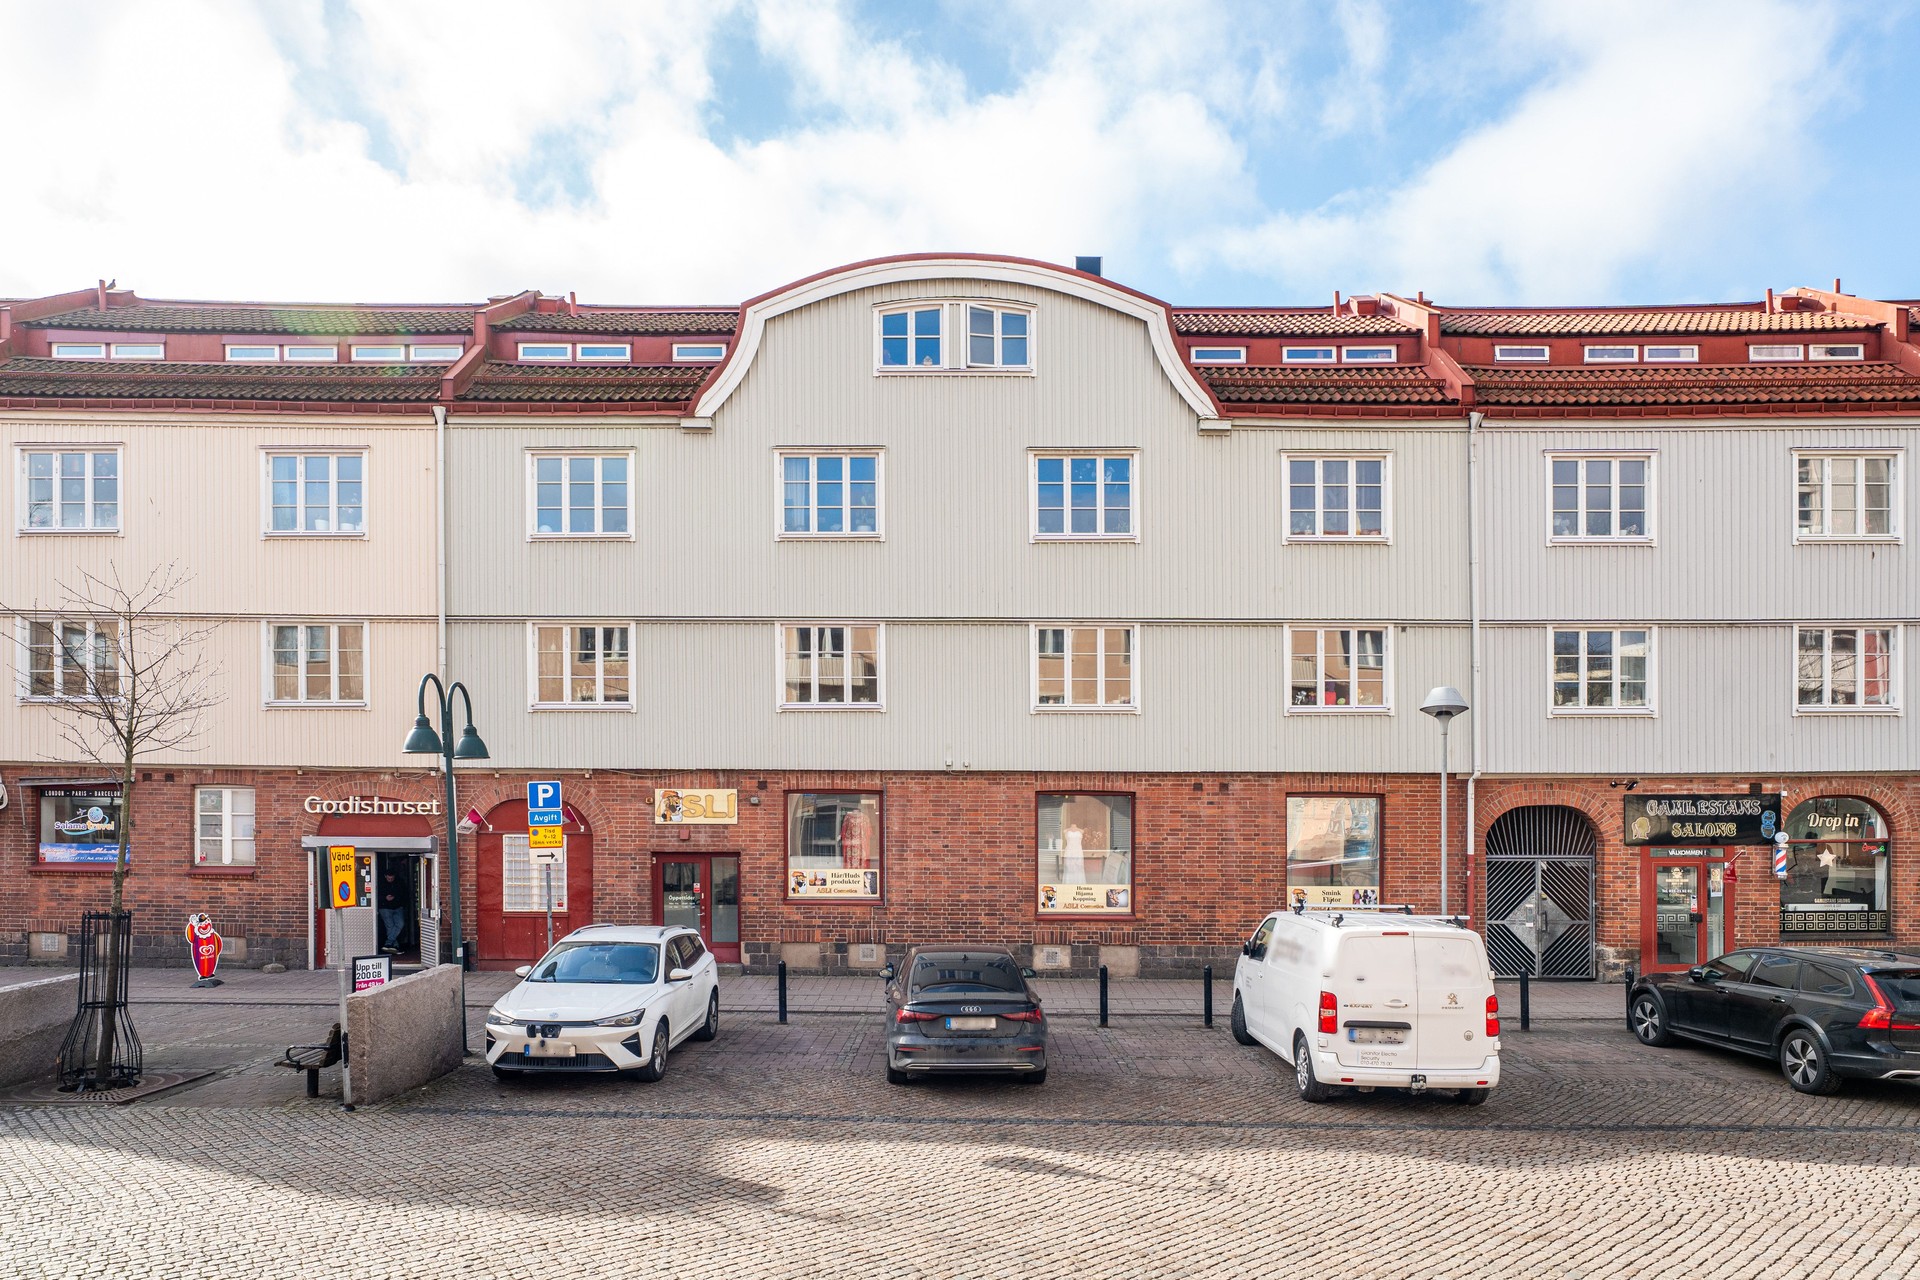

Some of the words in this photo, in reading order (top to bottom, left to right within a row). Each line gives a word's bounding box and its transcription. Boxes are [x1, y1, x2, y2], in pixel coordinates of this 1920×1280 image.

[538, 784, 554, 807] P
[304, 795, 441, 815] Godishuset
[1646, 799, 1762, 816] GAMLESTANS
[534, 814, 558, 823] Avgift
[1807, 812, 1842, 831] Drop
[1844, 813, 1859, 827] in
[1671, 822, 1737, 837] SALONG
[331, 851, 354, 861] Vänd-
[335, 863, 352, 875] plats
[356, 963, 371, 972] Upp
[371, 962, 382, 970] till
[356, 972, 371, 980] 200
[371, 970, 382, 979] GB
